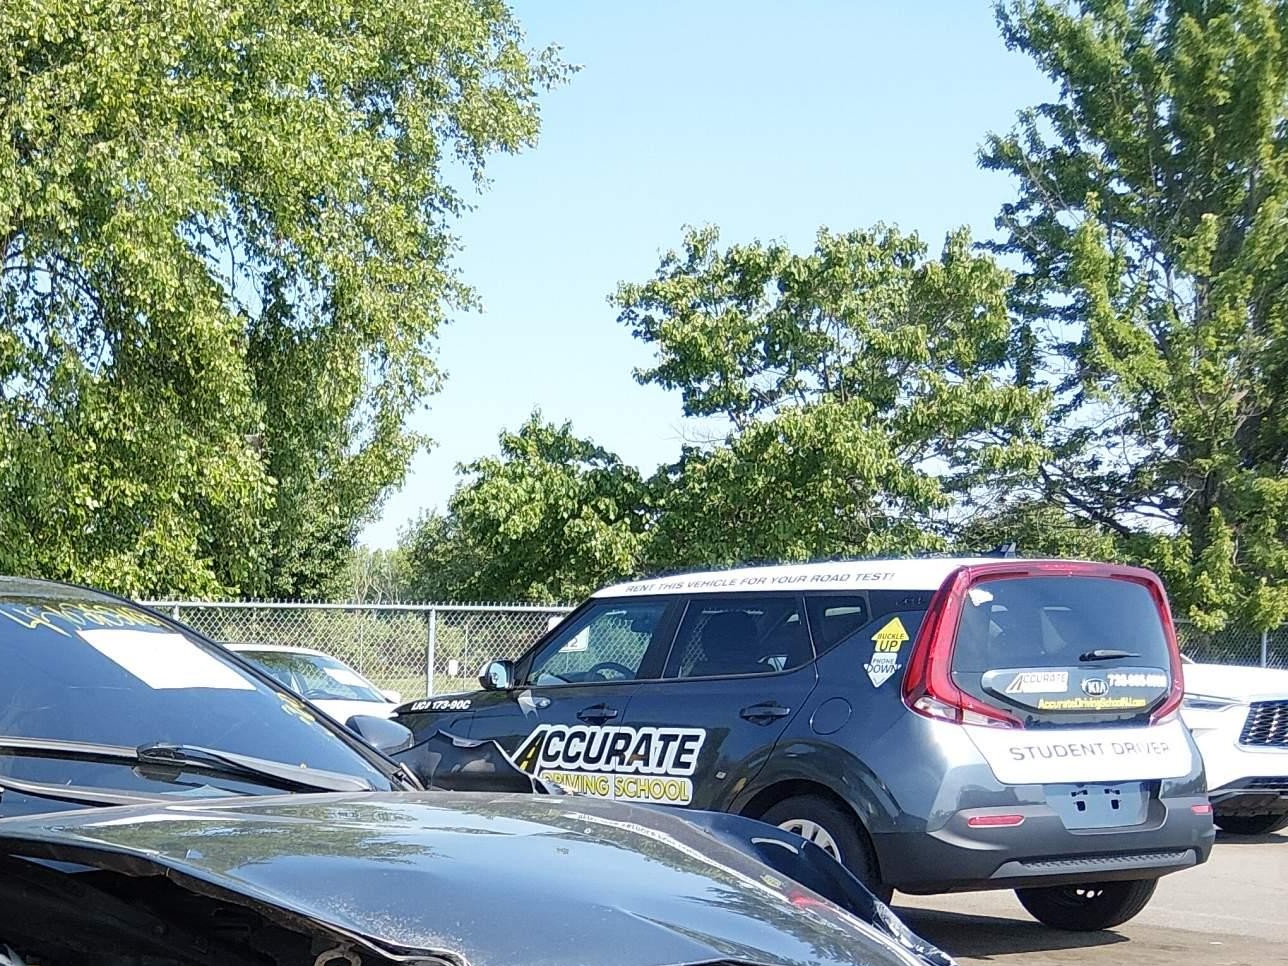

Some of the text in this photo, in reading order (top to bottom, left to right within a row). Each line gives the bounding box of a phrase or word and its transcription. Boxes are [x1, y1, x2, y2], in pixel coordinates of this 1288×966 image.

[625, 584, 655, 593] RENT
[658, 581, 683, 591] THIS
[687, 578, 737, 588] VEHICLE
[740, 576, 766, 586] FOR
[770, 574, 808, 585] YOUR
[810, 573, 851, 583] ROAD
[879, 640, 899, 653] UP
[866, 664, 900, 674] DOWN
[513, 728, 702, 777] ACCURATE
[1009, 742, 1106, 761] STUDENT
[615, 777, 690, 802] SCHOOL
